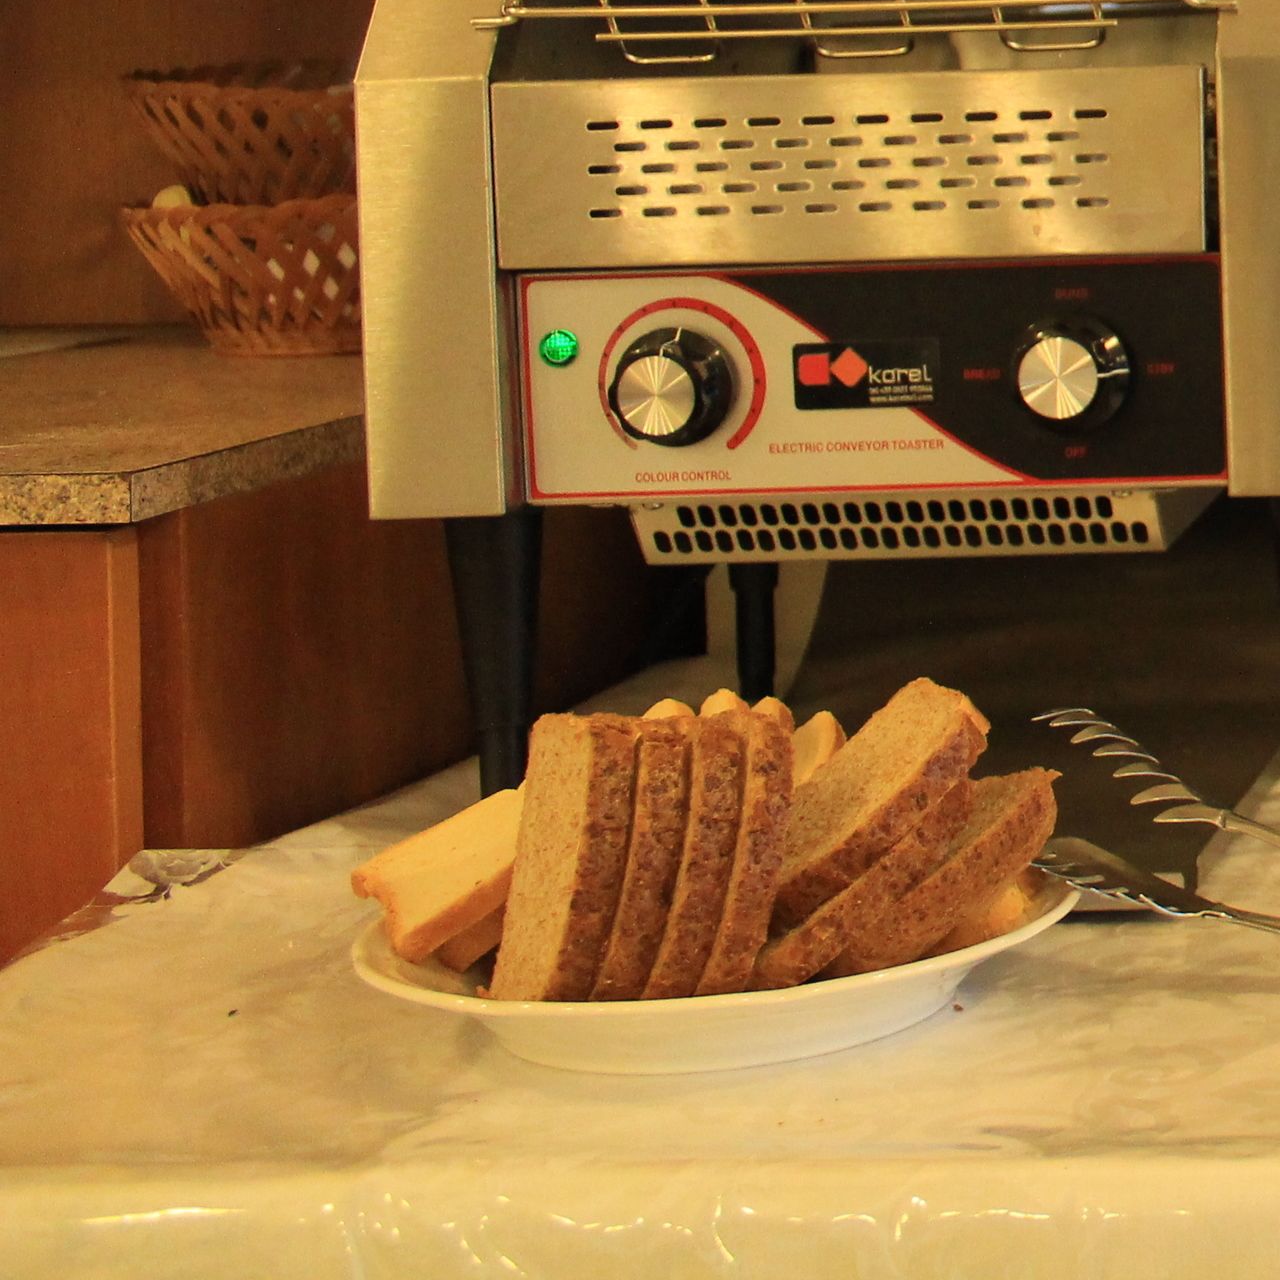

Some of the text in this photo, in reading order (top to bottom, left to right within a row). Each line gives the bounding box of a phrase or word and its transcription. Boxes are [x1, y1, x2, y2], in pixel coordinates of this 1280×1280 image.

[868, 363, 932, 384] karel
[768, 438, 945, 454] ELECTRIC CONVEYOR TOASTER
[635, 470, 732, 483] COLOUR CONTROL
